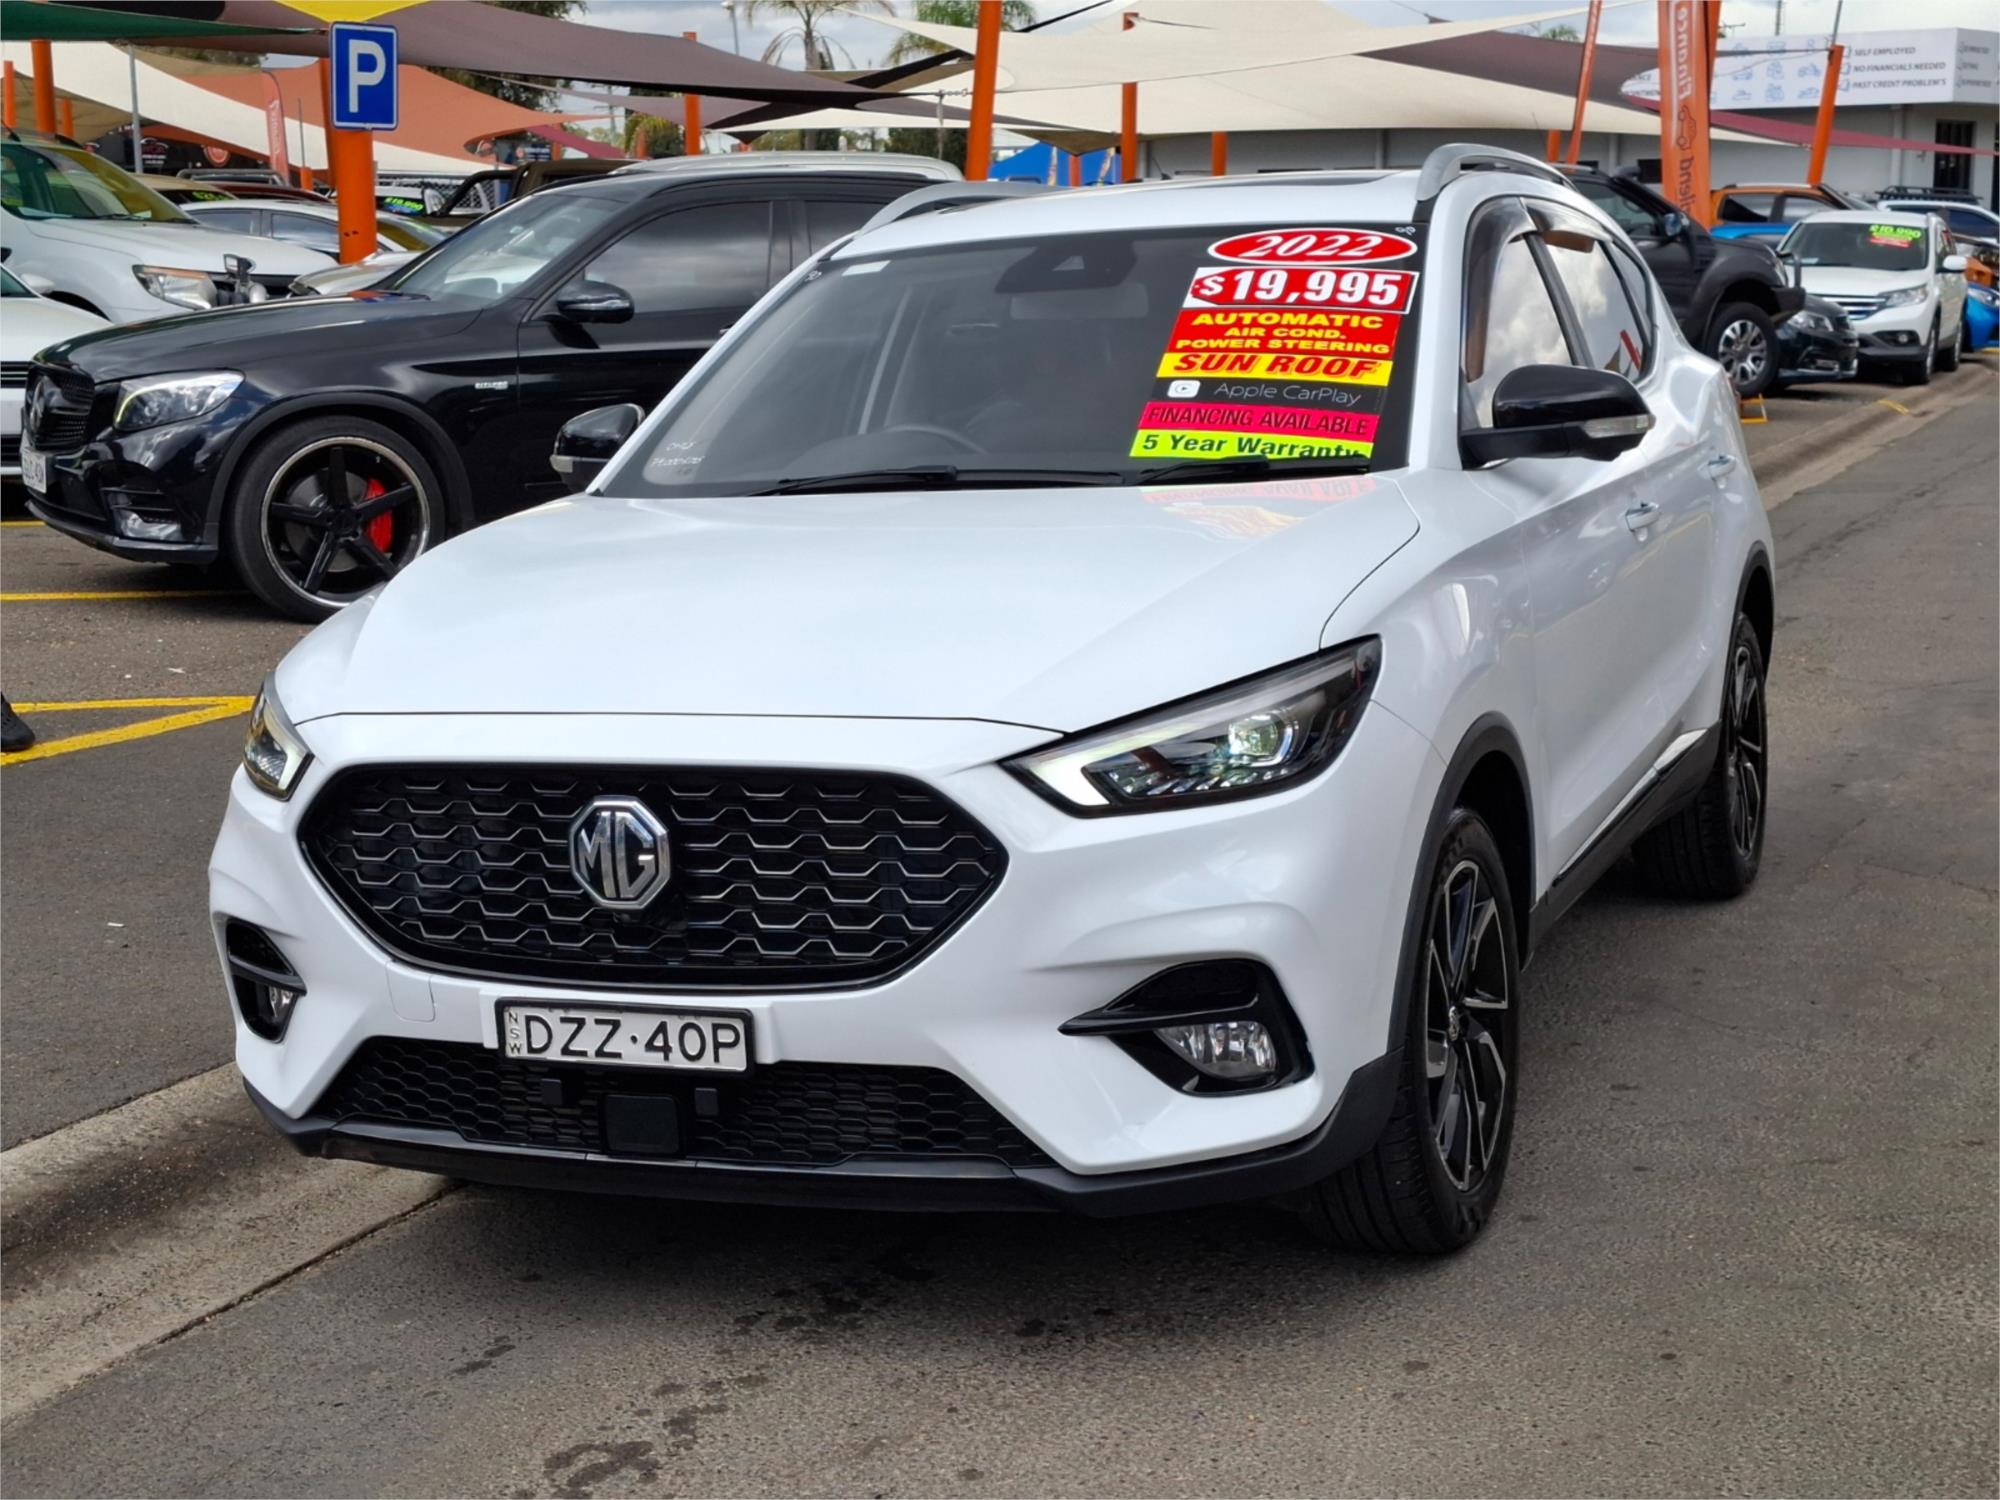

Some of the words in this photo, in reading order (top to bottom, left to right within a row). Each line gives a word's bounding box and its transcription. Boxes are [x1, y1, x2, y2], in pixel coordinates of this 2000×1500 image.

[1872, 47, 1916, 56] EMPLOYED
[348, 39, 386, 113] P
[1867, 63, 1912, 72] FINANCIALS
[1914, 62, 1946, 70] NEEDED
[1238, 234, 1383, 257] 2022
[1199, 268, 1402, 305] $19,995
[1191, 312, 1384, 329] AUTOMATIC
[1224, 327, 1266, 337] AIR
[1272, 327, 1347, 339] COND.
[1176, 339, 1261, 349] POWER
[1267, 339, 1390, 354] STEERING
[1173, 353, 1259, 374] SUN
[1266, 356, 1380, 378] ROOF
[1213, 383, 1277, 399] Apple
[1283, 384, 1362, 406] CarPlay
[1147, 407, 1254, 426] FINANCING
[1258, 410, 1369, 435] AVAILABLE
[1142, 434, 1158, 450] 5
[1170, 434, 1228, 452] Year
[578, 811, 656, 898] MG
